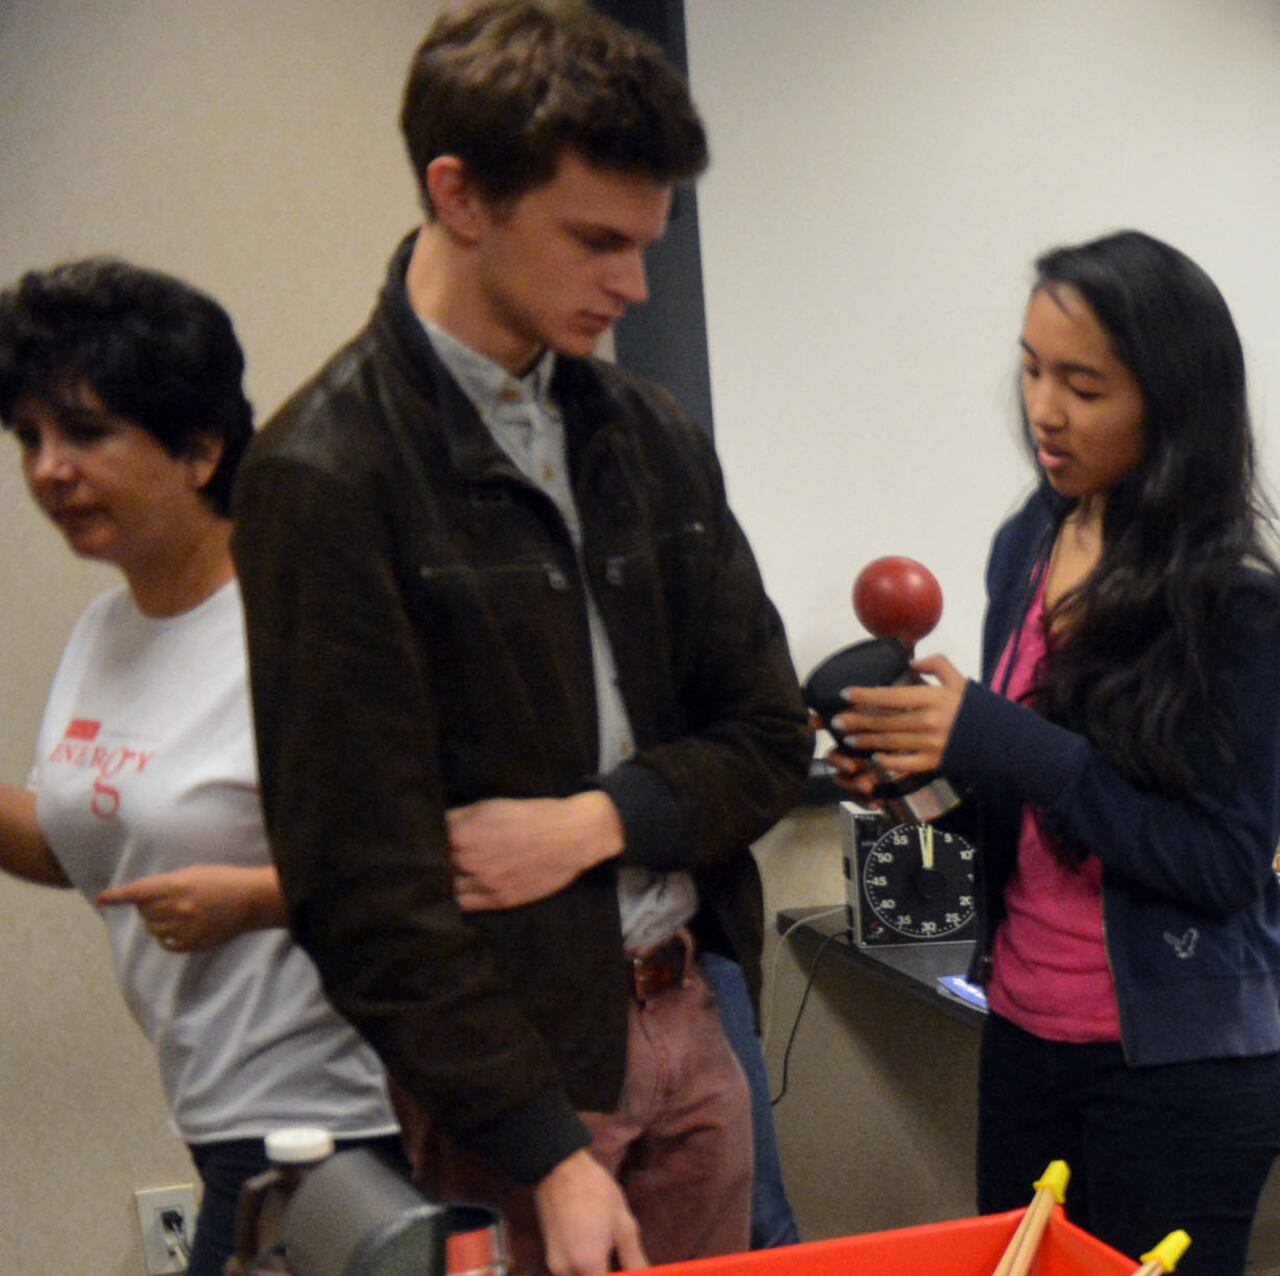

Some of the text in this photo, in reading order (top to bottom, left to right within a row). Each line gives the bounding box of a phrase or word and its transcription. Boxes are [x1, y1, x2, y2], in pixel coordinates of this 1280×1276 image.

[893, 835, 909, 845] 55
[944, 832, 953, 844] 5
[877, 852, 893, 863] 50
[960, 850, 973, 860] 10
[873, 876, 887, 886] 45
[880, 899, 896, 909] 40
[897, 915, 911, 925] 35
[945, 913, 959, 923] 25
[921, 922, 936, 932] 30
